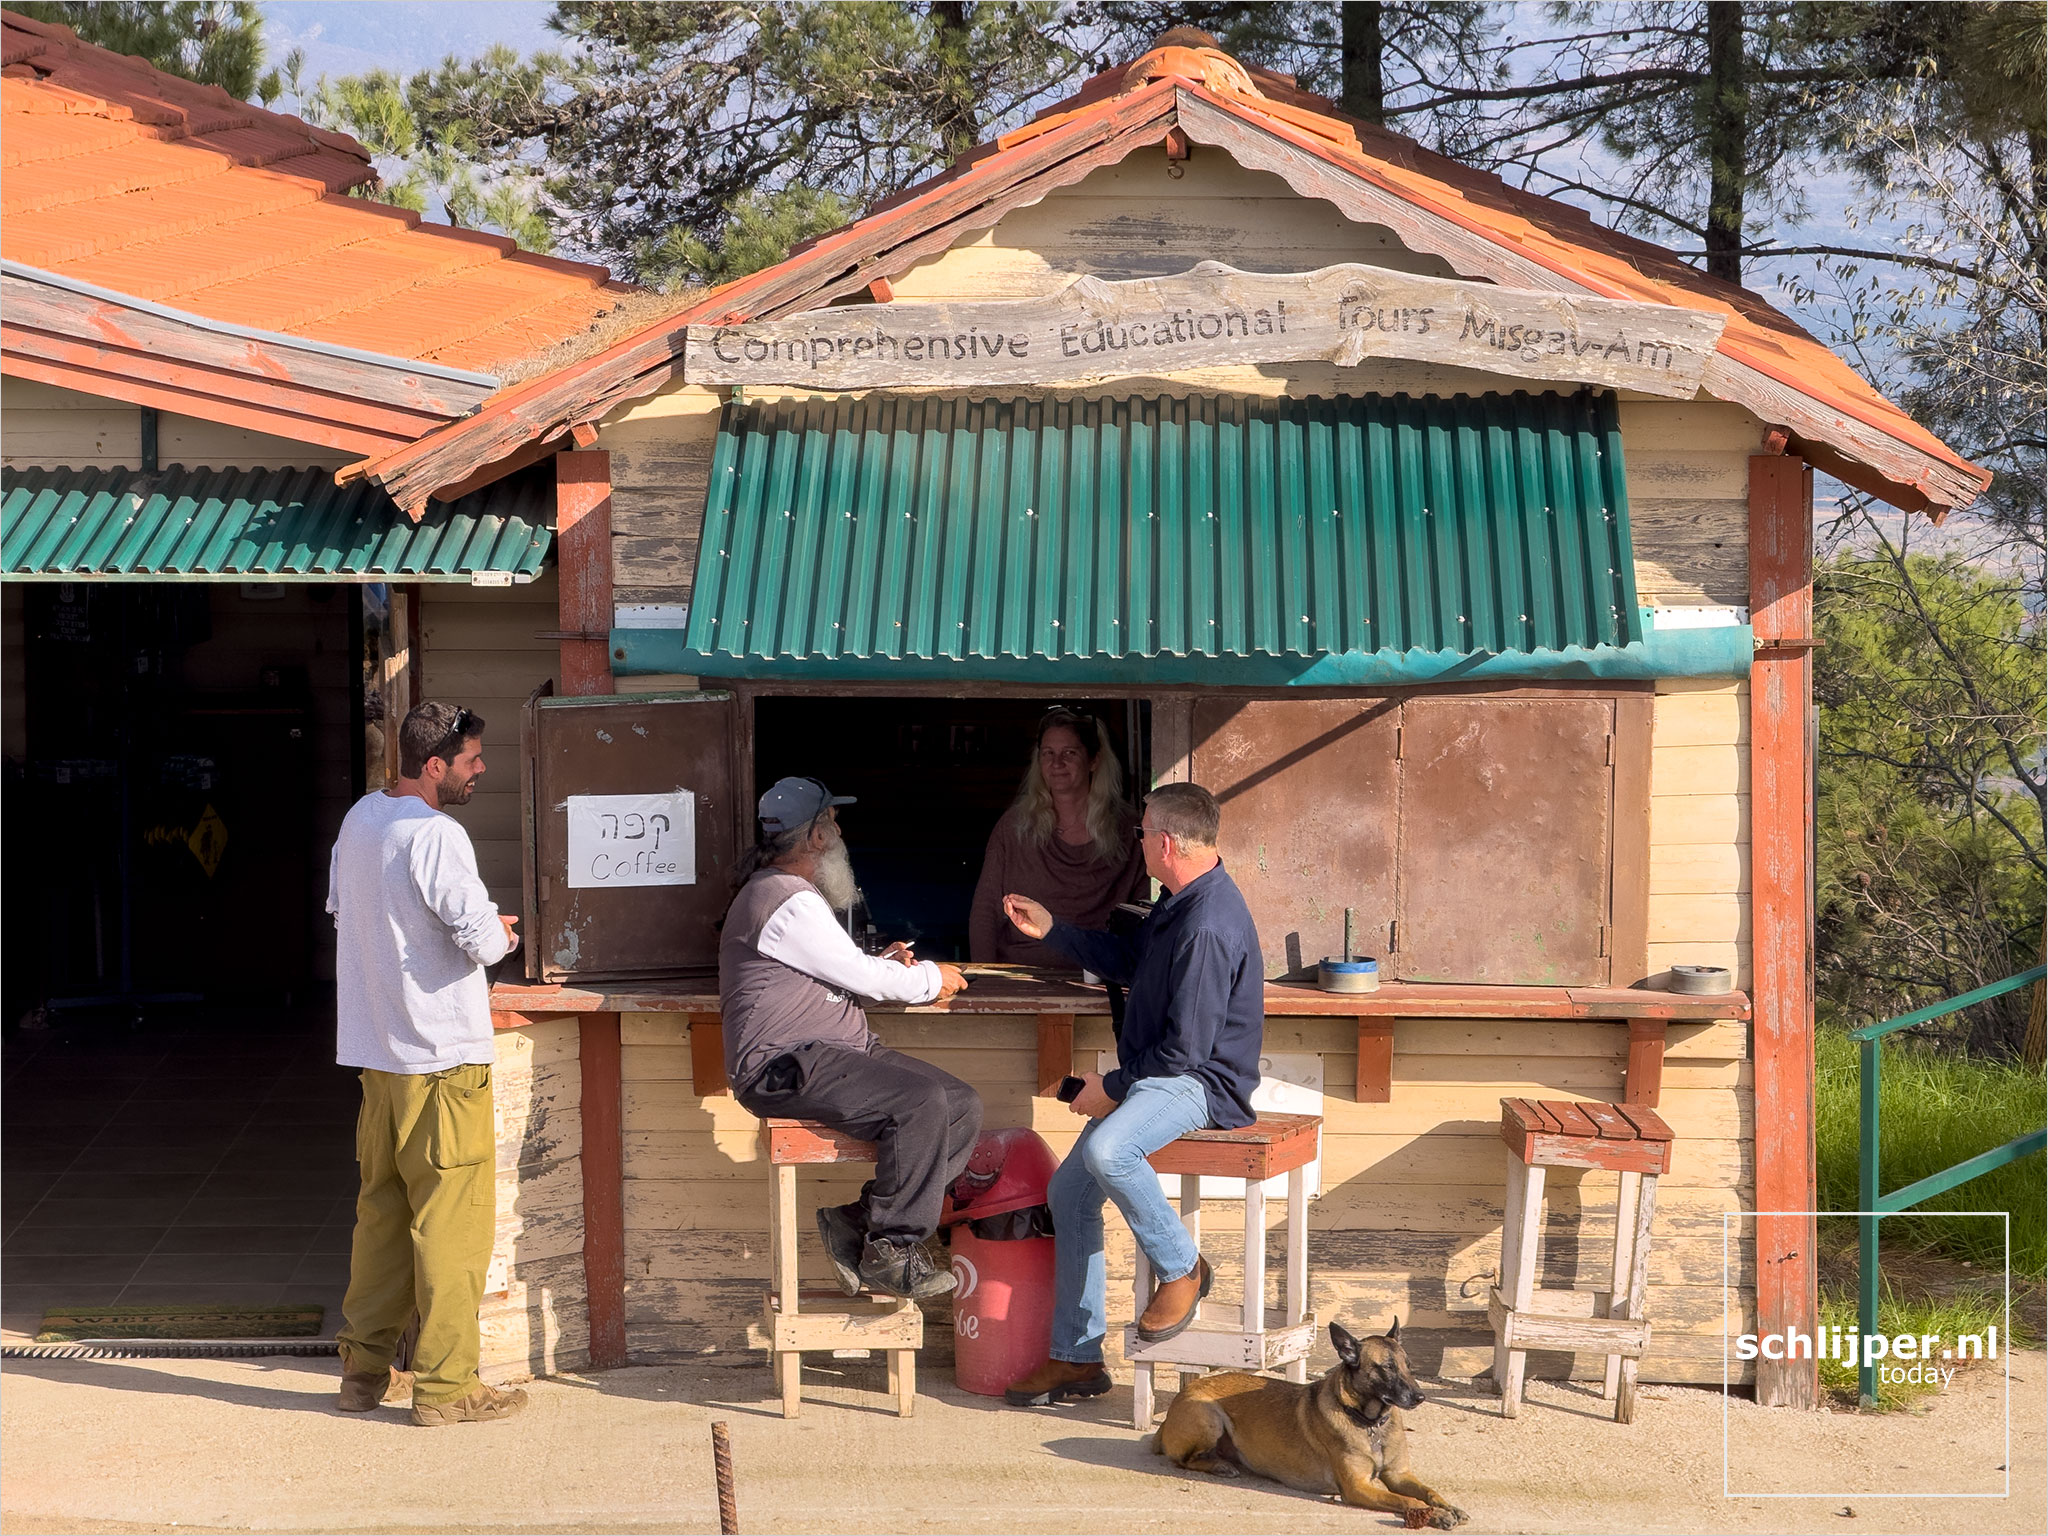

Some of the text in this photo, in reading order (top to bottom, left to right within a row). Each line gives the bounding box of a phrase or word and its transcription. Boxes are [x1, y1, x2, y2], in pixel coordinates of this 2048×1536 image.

[712, 296, 1674, 370] Comprehensive Educational Tours Misgav-Am
[600, 812, 671, 850] קפה
[590, 850, 678, 881] Coffee
[71, 1313, 299, 1324] WELCOME
